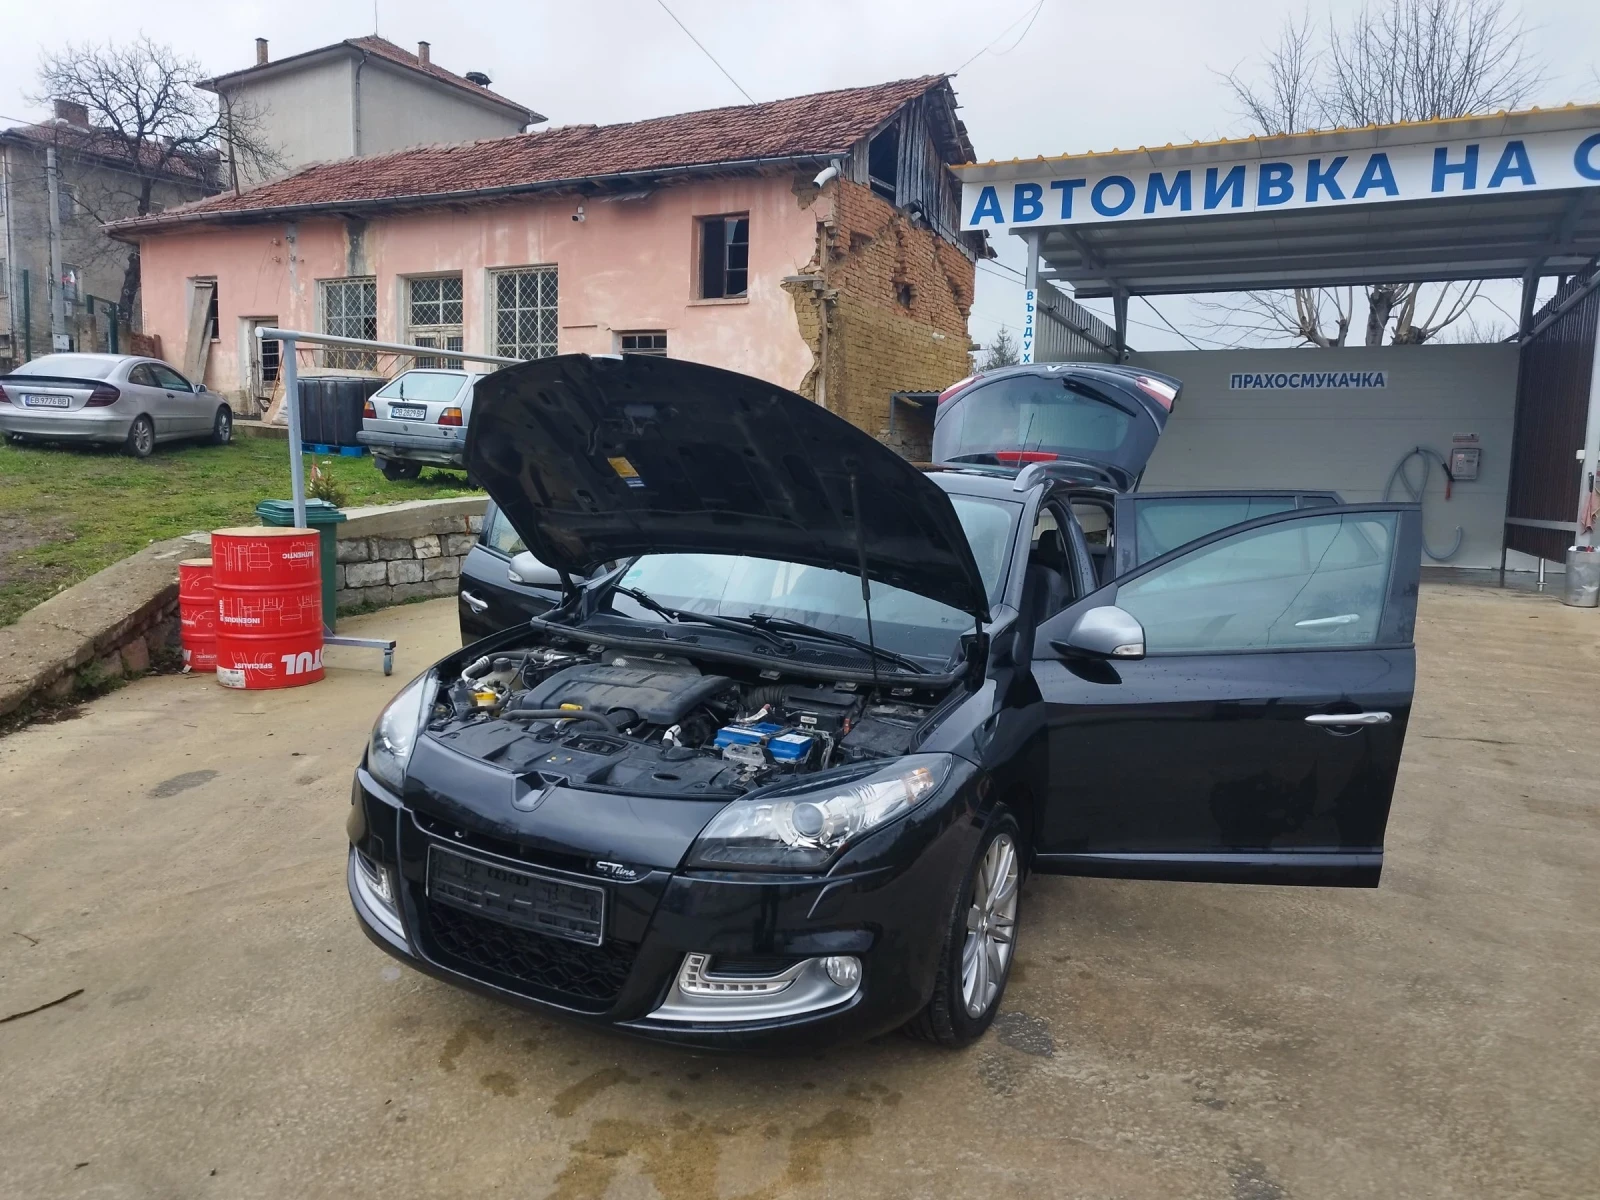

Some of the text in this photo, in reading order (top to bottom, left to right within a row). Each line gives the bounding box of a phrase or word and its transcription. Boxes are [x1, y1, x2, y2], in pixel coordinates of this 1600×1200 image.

[969, 152, 1400, 226] АВТОМИВКА
[1431, 139, 1537, 193] НА
[1023, 290, 1034, 363] ВЪЗДУХ
[1231, 372, 1385, 388] ПРАХОСМУКАЧКА
[40, 397, 57, 405] 9776
[282, 551, 314, 560] AUTHENTIC
[224, 616, 260, 624] INGENIOUS
[281, 644, 325, 676] TUL
